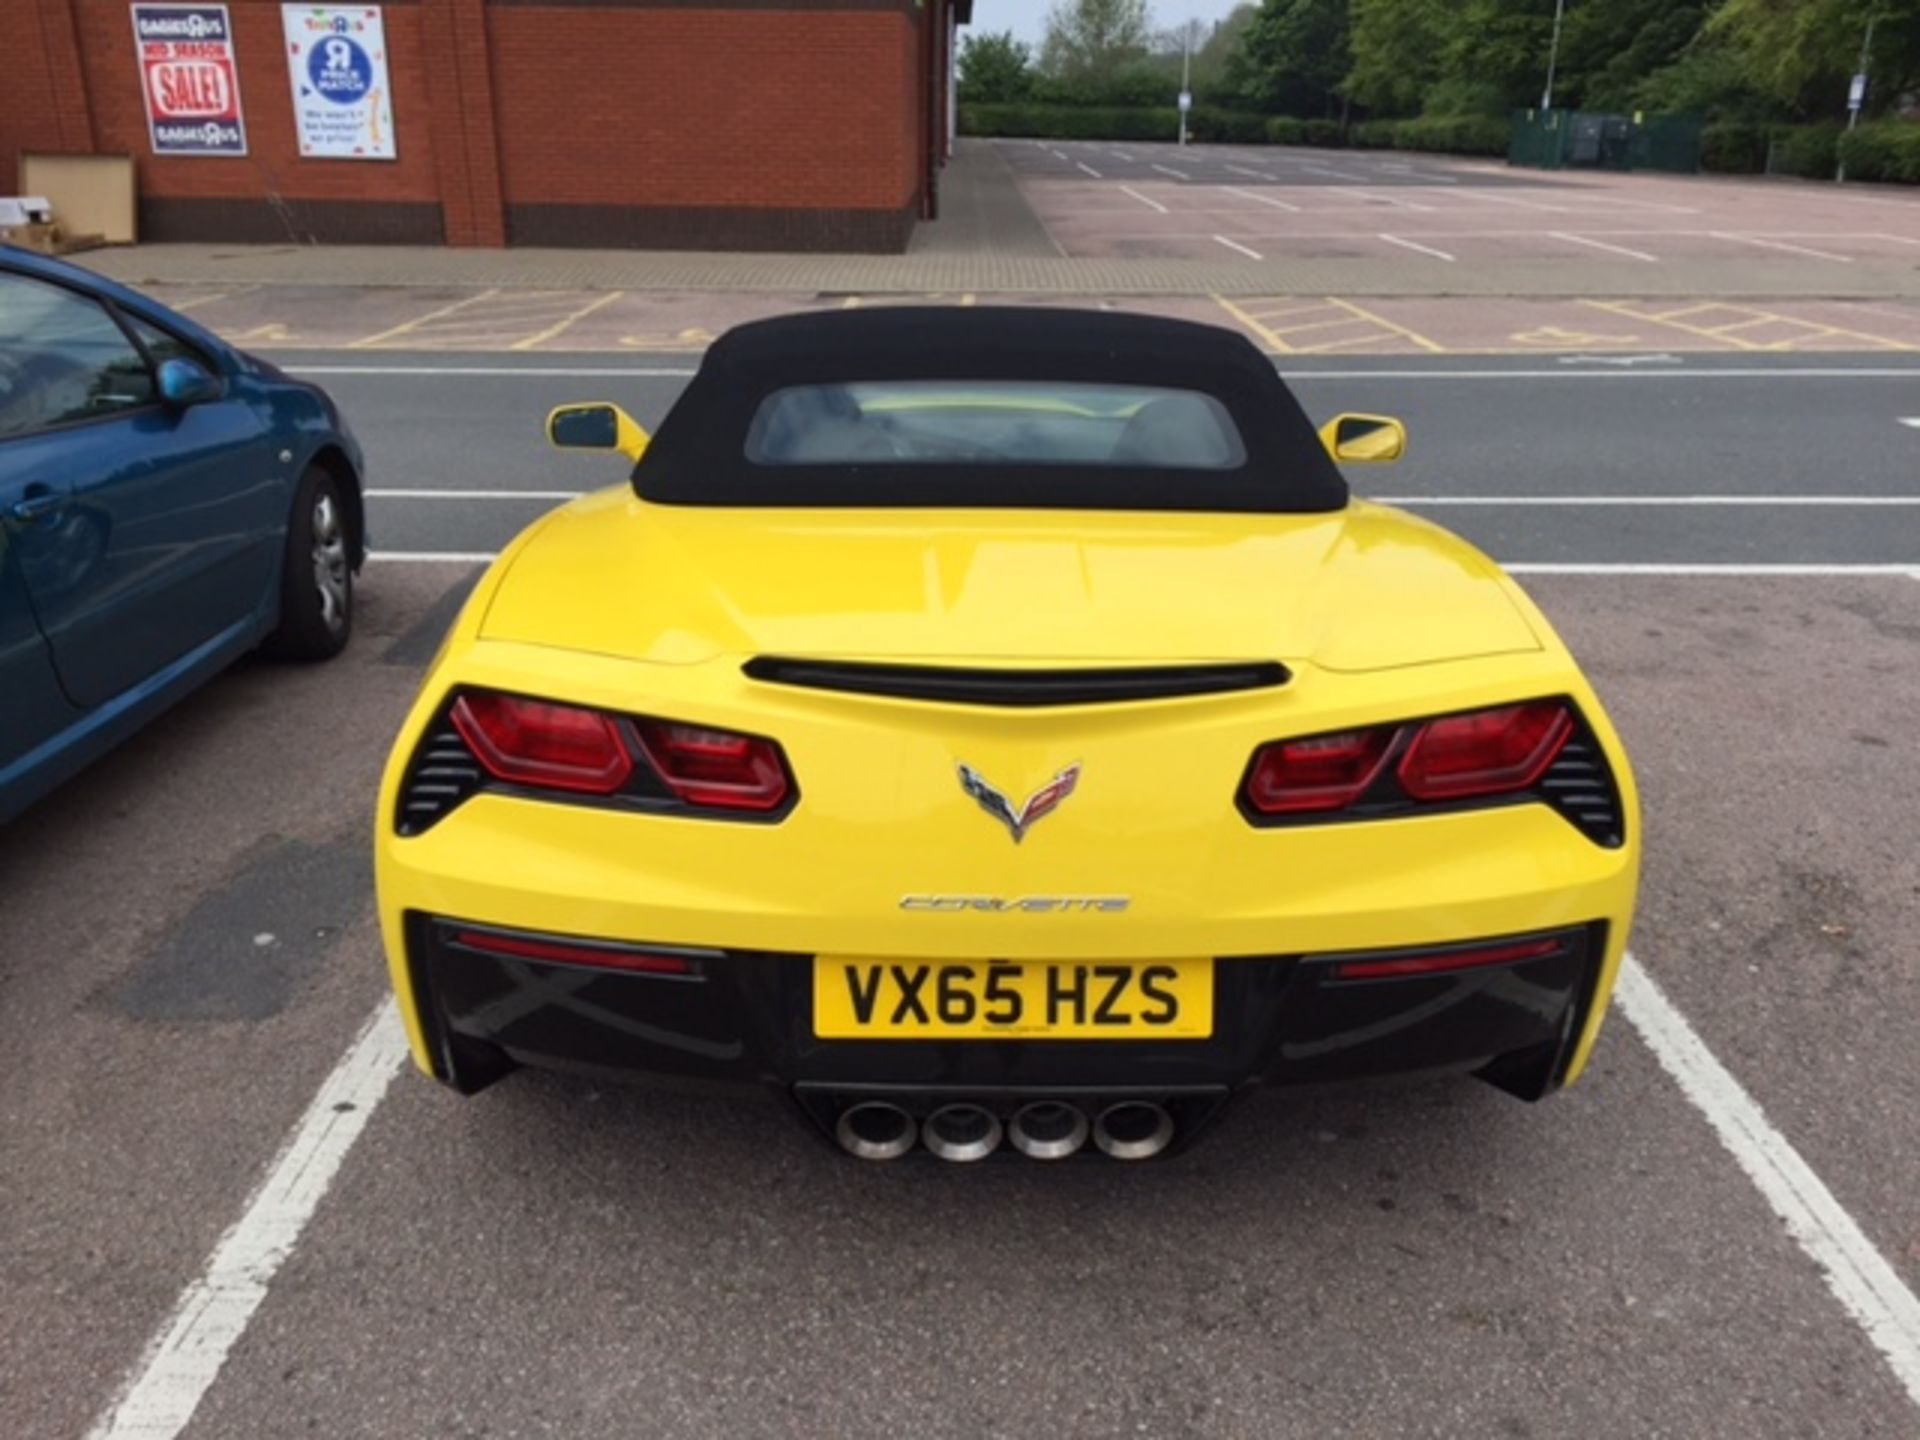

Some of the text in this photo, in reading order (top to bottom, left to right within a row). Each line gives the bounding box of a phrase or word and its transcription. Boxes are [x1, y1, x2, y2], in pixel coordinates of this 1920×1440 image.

[320, 69, 360, 80] PRICE
[160, 65, 222, 110] SALE!
[318, 79, 364, 91] MATCH
[900, 895, 1130, 911] CORVETTE
[845, 965, 1179, 1025] VX65 HZS
